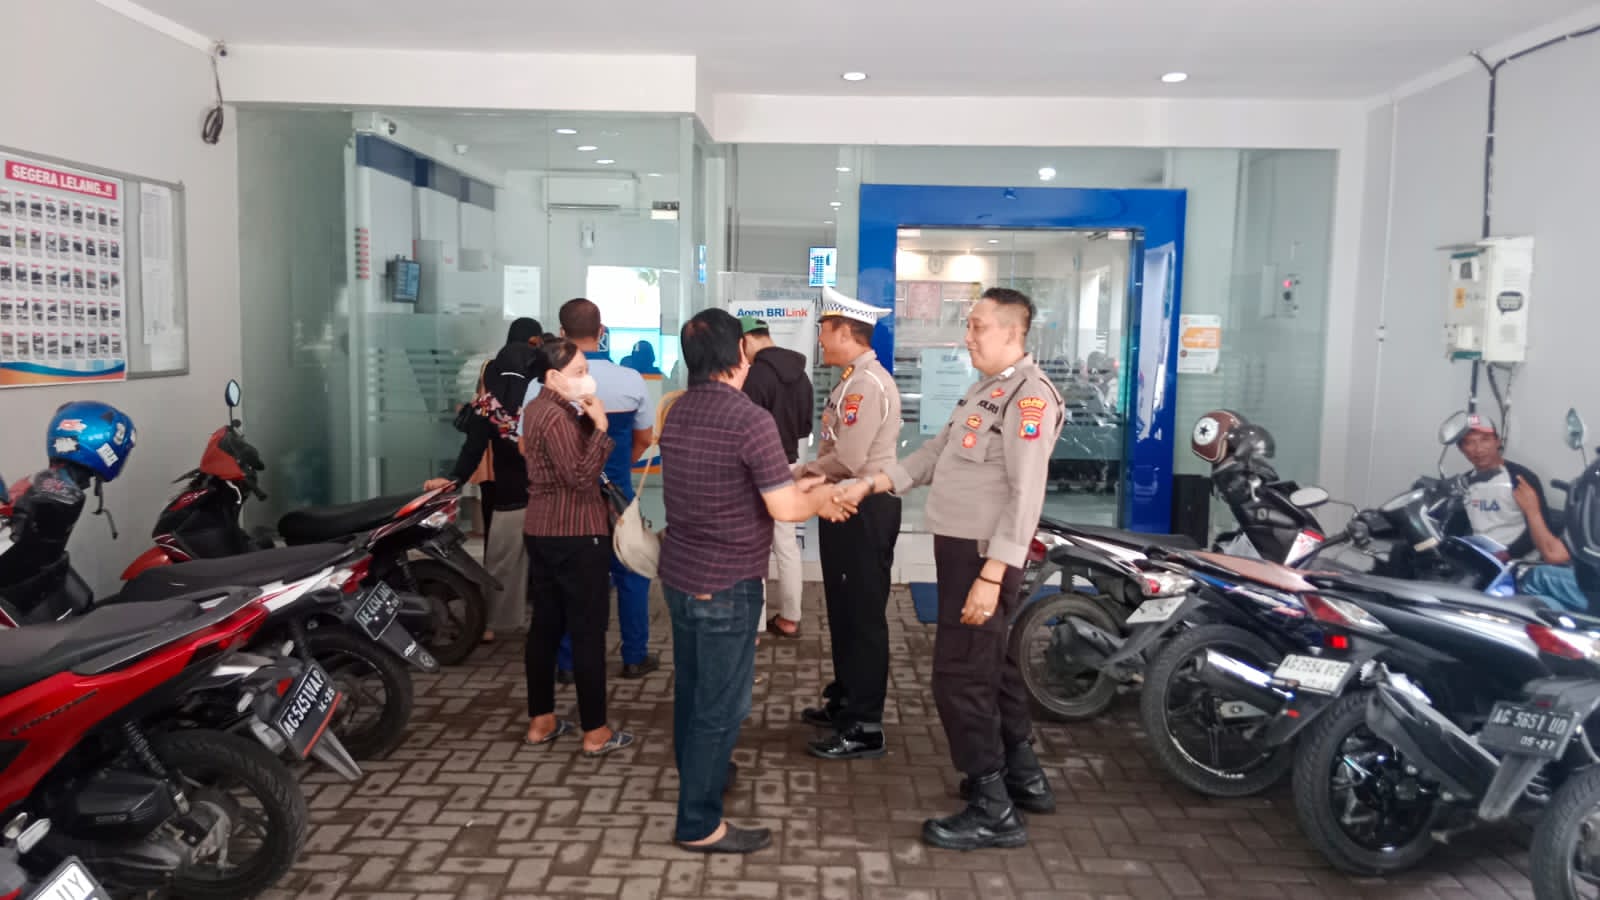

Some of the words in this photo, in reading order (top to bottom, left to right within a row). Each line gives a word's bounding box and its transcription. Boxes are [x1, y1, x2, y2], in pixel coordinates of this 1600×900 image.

[12, 164, 59, 187] SEGERA
[766, 308, 808, 317] BRILink
[1471, 499, 1501, 511] FILA
[283, 713, 299, 737] AG
[292, 689, 316, 721] 5451
[305, 670, 324, 697] VAP
